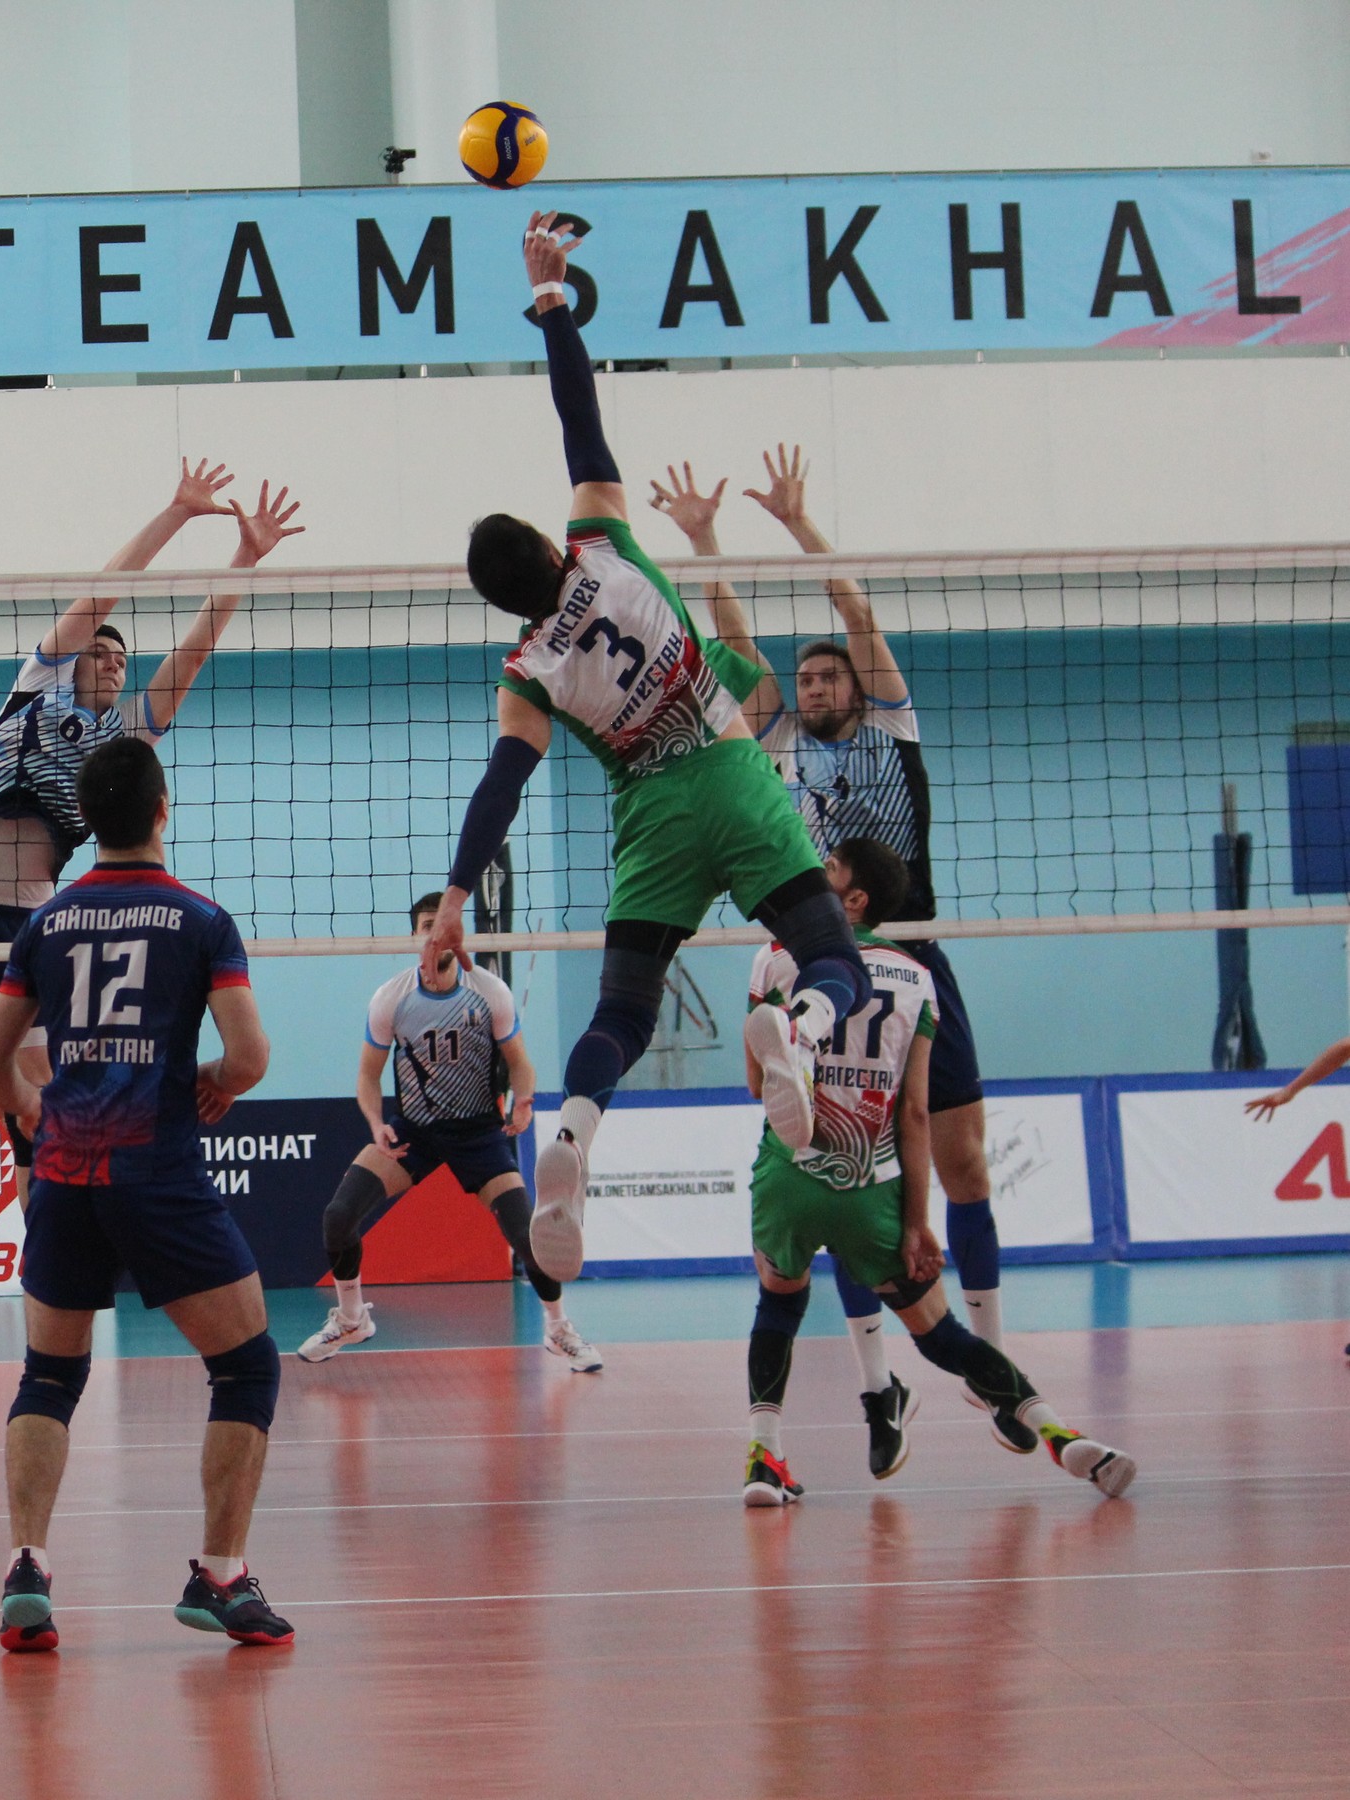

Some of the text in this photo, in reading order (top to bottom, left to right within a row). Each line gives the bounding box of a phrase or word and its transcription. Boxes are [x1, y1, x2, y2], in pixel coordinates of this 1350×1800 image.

[575, 616, 646, 692] 3
[65, 939, 149, 1028] 12
[423, 1029, 459, 1063] 11
[199, 1134, 317, 1162] ПИОНАТ
